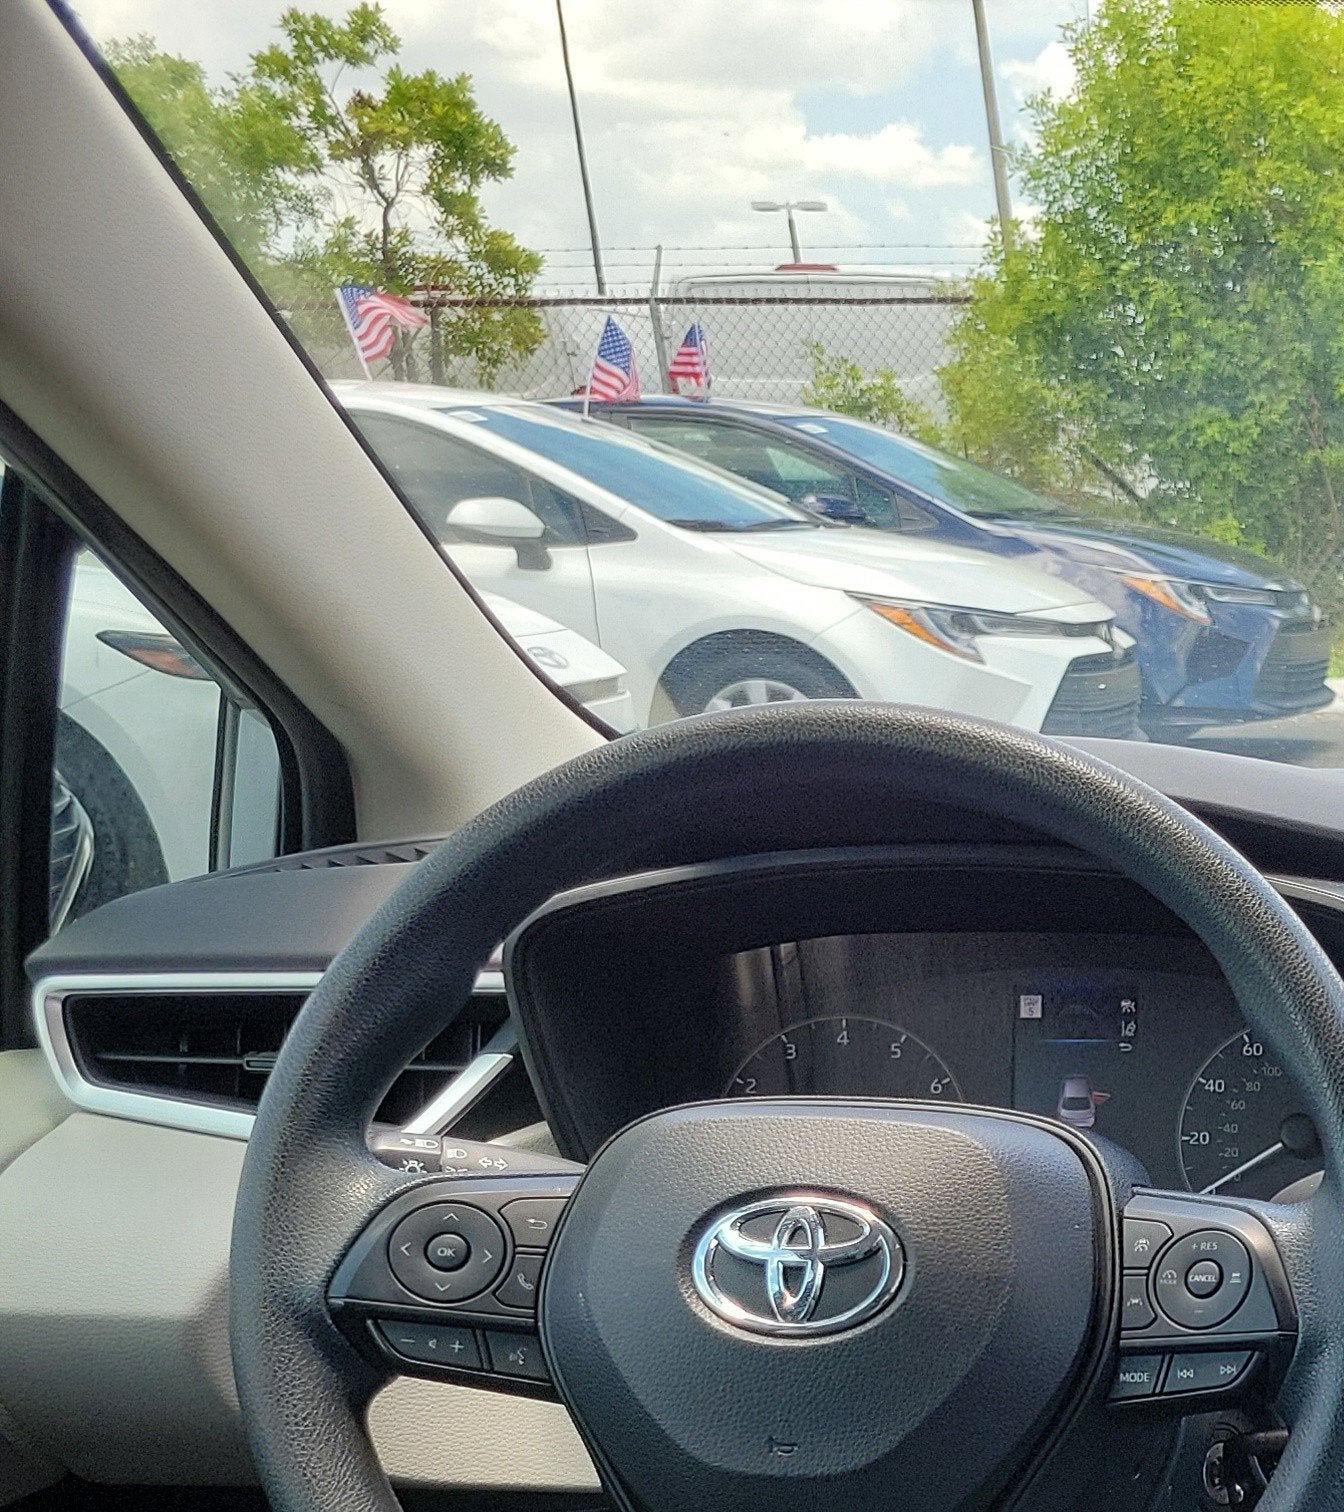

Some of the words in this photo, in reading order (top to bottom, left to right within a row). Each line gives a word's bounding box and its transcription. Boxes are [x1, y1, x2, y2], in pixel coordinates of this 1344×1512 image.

[836, 1030, 850, 1046] 4
[785, 1043, 797, 1060] 3
[890, 1043, 902, 1059] 5
[1242, 1042, 1264, 1056] 60
[1261, 1066, 1283, 1078] 100
[745, 1078, 757, 1094] 2
[930, 1078, 943, 1094] 6
[1204, 1079, 1226, 1093] 40
[1245, 1081, 1262, 1092] 80
[1230, 1100, 1247, 1111] 60
[1223, 1123, 1239, 1134] 40
[1189, 1131, 1211, 1145] 20
[1223, 1147, 1240, 1158] 20
[437, 1247, 456, 1257] OK
[1200, 1241, 1218, 1251] RES
[1189, 1274, 1218, 1283] CANCEL
[1120, 1372, 1151, 1383] MODE
